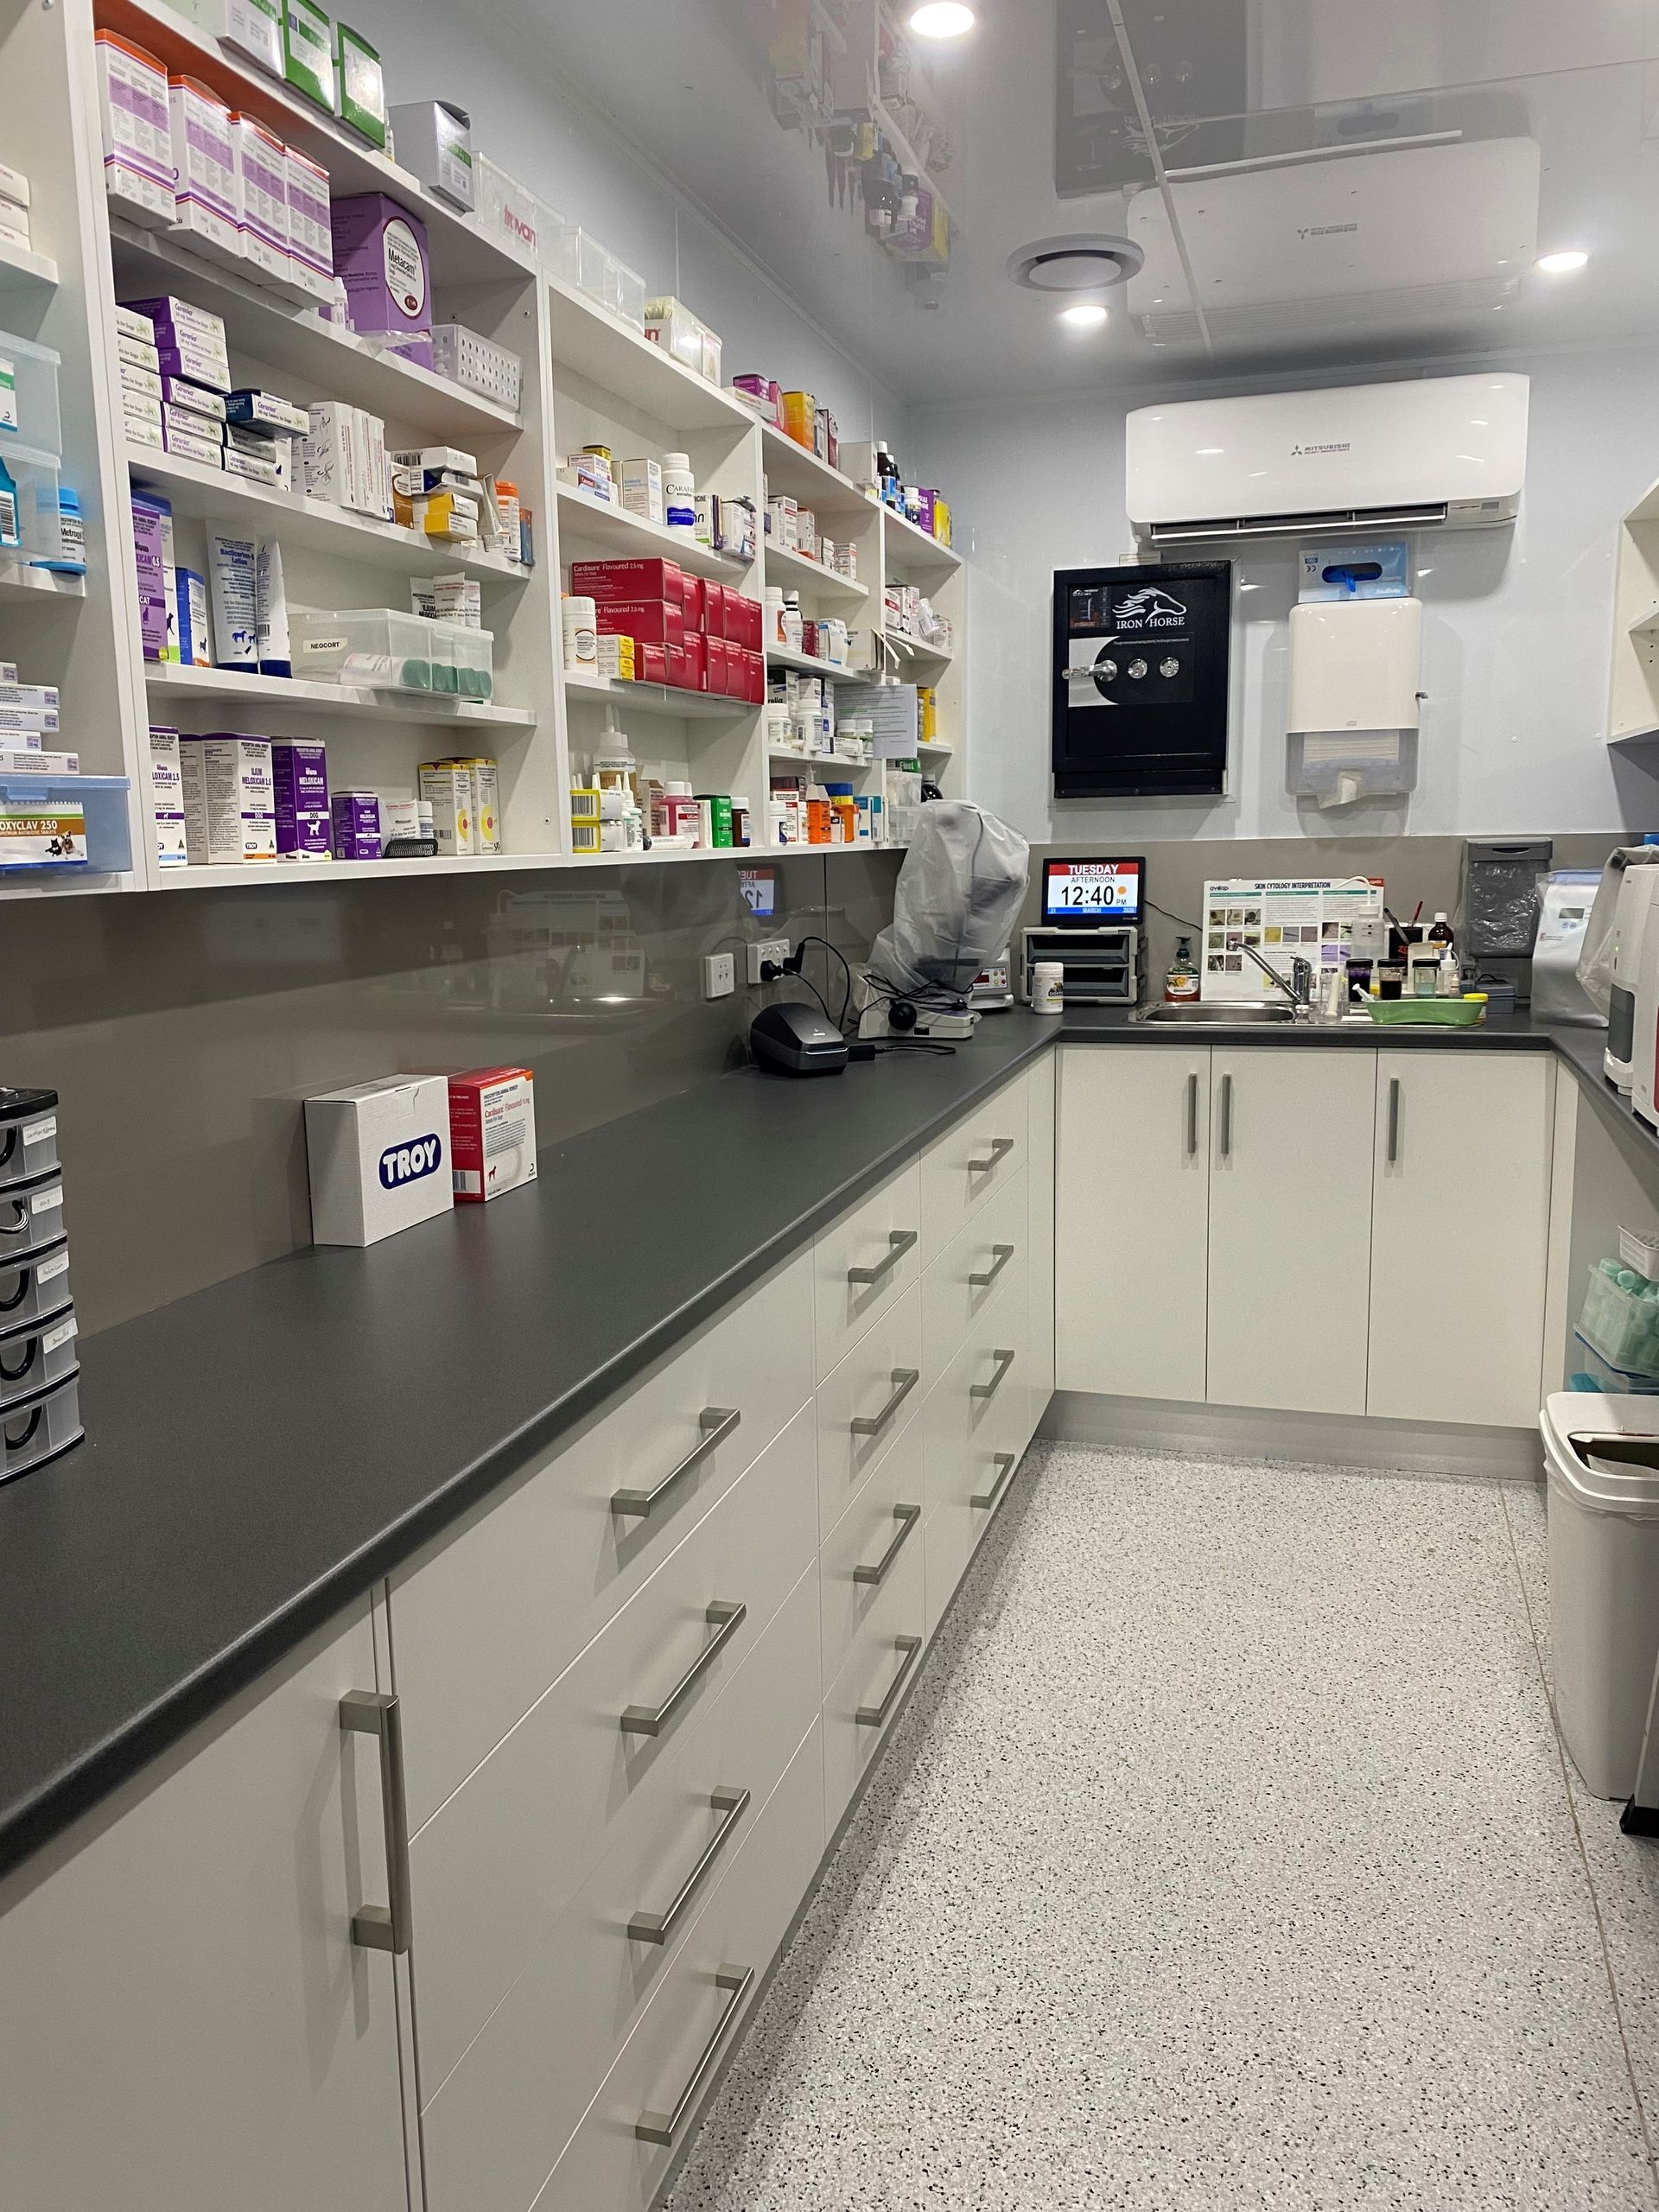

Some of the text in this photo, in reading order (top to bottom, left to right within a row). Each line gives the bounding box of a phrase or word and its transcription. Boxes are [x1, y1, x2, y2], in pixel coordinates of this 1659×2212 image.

[503, 204, 537, 247] trovan
[387, 247, 416, 275] Metacam
[175, 302, 194, 316] Cerenia
[180, 330, 197, 342] Cerenia
[175, 384, 194, 397] Cerenia
[257, 401, 277, 413] Cerenia
[169, 408, 189, 420] Cerenia
[1305, 442, 1351, 451] MITSUBISHI
[152, 556, 161, 567] 0.5
[232, 556, 248, 565] Lotion
[602, 562, 629, 570] Flavoured
[138, 595, 150, 605] CAT
[604, 605, 630, 613] Flavoured
[1116, 616, 1185, 630] IRON HORSE
[310, 641, 340, 650] NEOCORT
[242, 776, 265, 785] MELOXICAM
[299, 776, 324, 785] MELOXICAM
[0, 820, 58, 831] OXYCLAV 250
[1068, 864, 1119, 875] TUESDAY
[1061, 886, 1114, 906] 12:40
[484, 1090, 501, 1099] PRESCRIPTION
[484, 1106, 504, 1118] Cardisure
[505, 1099, 522, 1109] Flavoured
[382, 1139, 436, 1184] TROY
